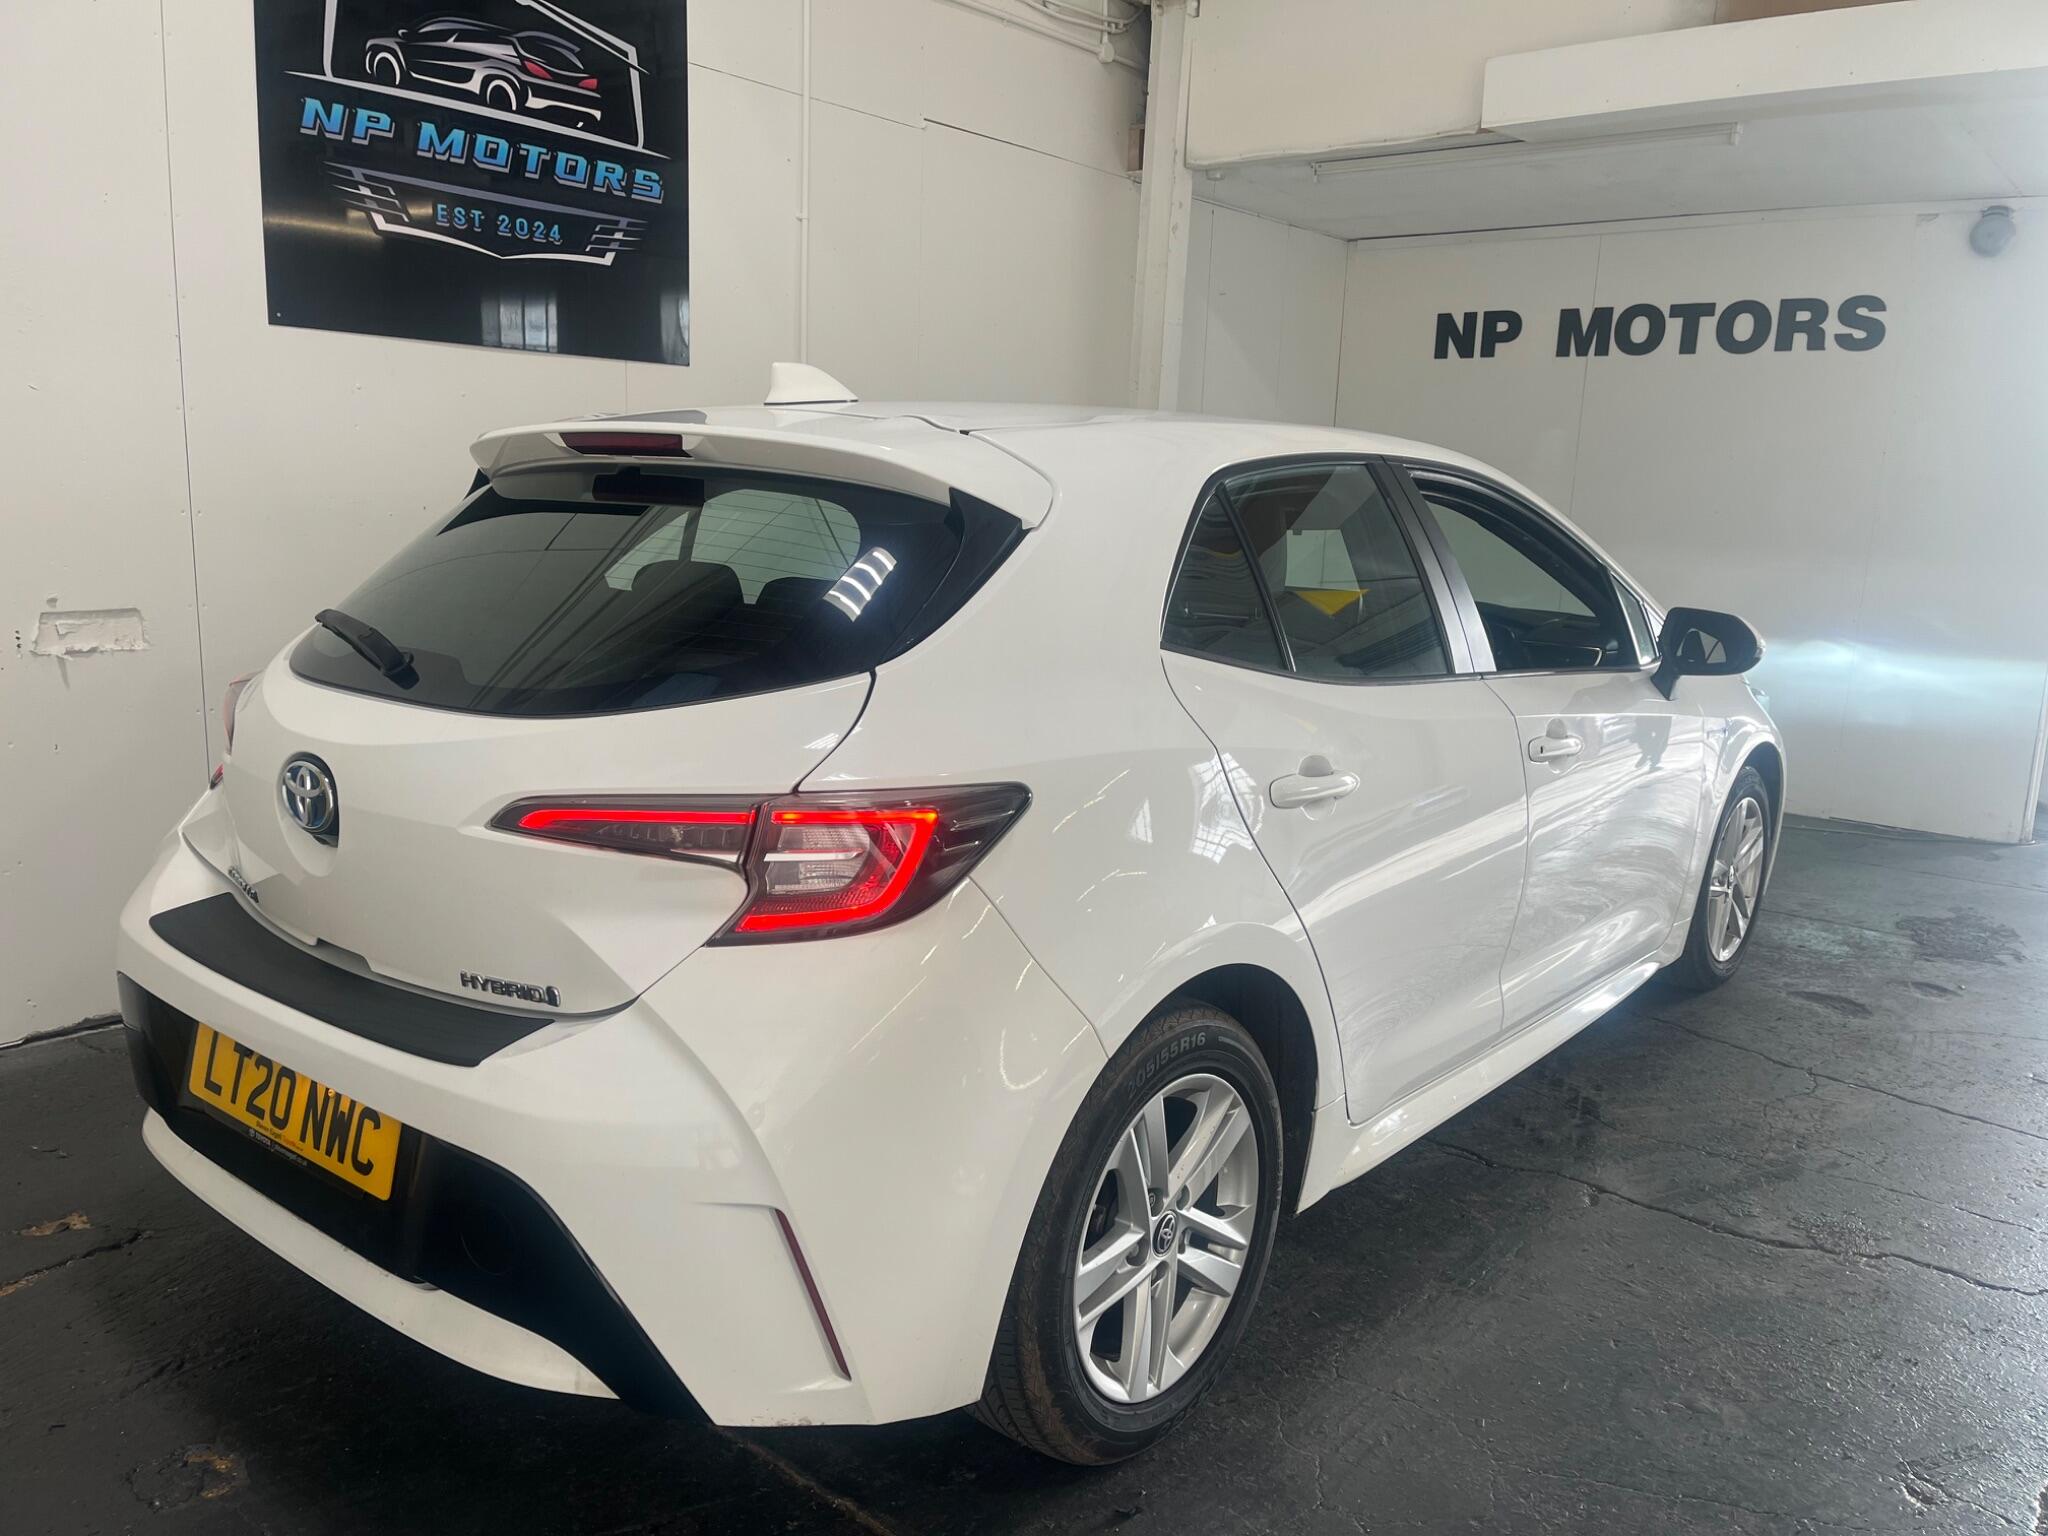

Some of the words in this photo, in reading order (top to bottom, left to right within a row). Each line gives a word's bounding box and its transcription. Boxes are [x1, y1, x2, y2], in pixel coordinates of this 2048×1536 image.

[300, 96, 395, 145] NP
[416, 120, 664, 204] MOTORS
[435, 202, 485, 232] EST
[497, 213, 563, 245] 2024
[1433, 309, 1523, 360] NP
[1555, 294, 1888, 358] MOTORS
[460, 969, 546, 1004] HYBRID
[203, 1030, 297, 1131] LT20
[300, 1079, 381, 1176] NWC
